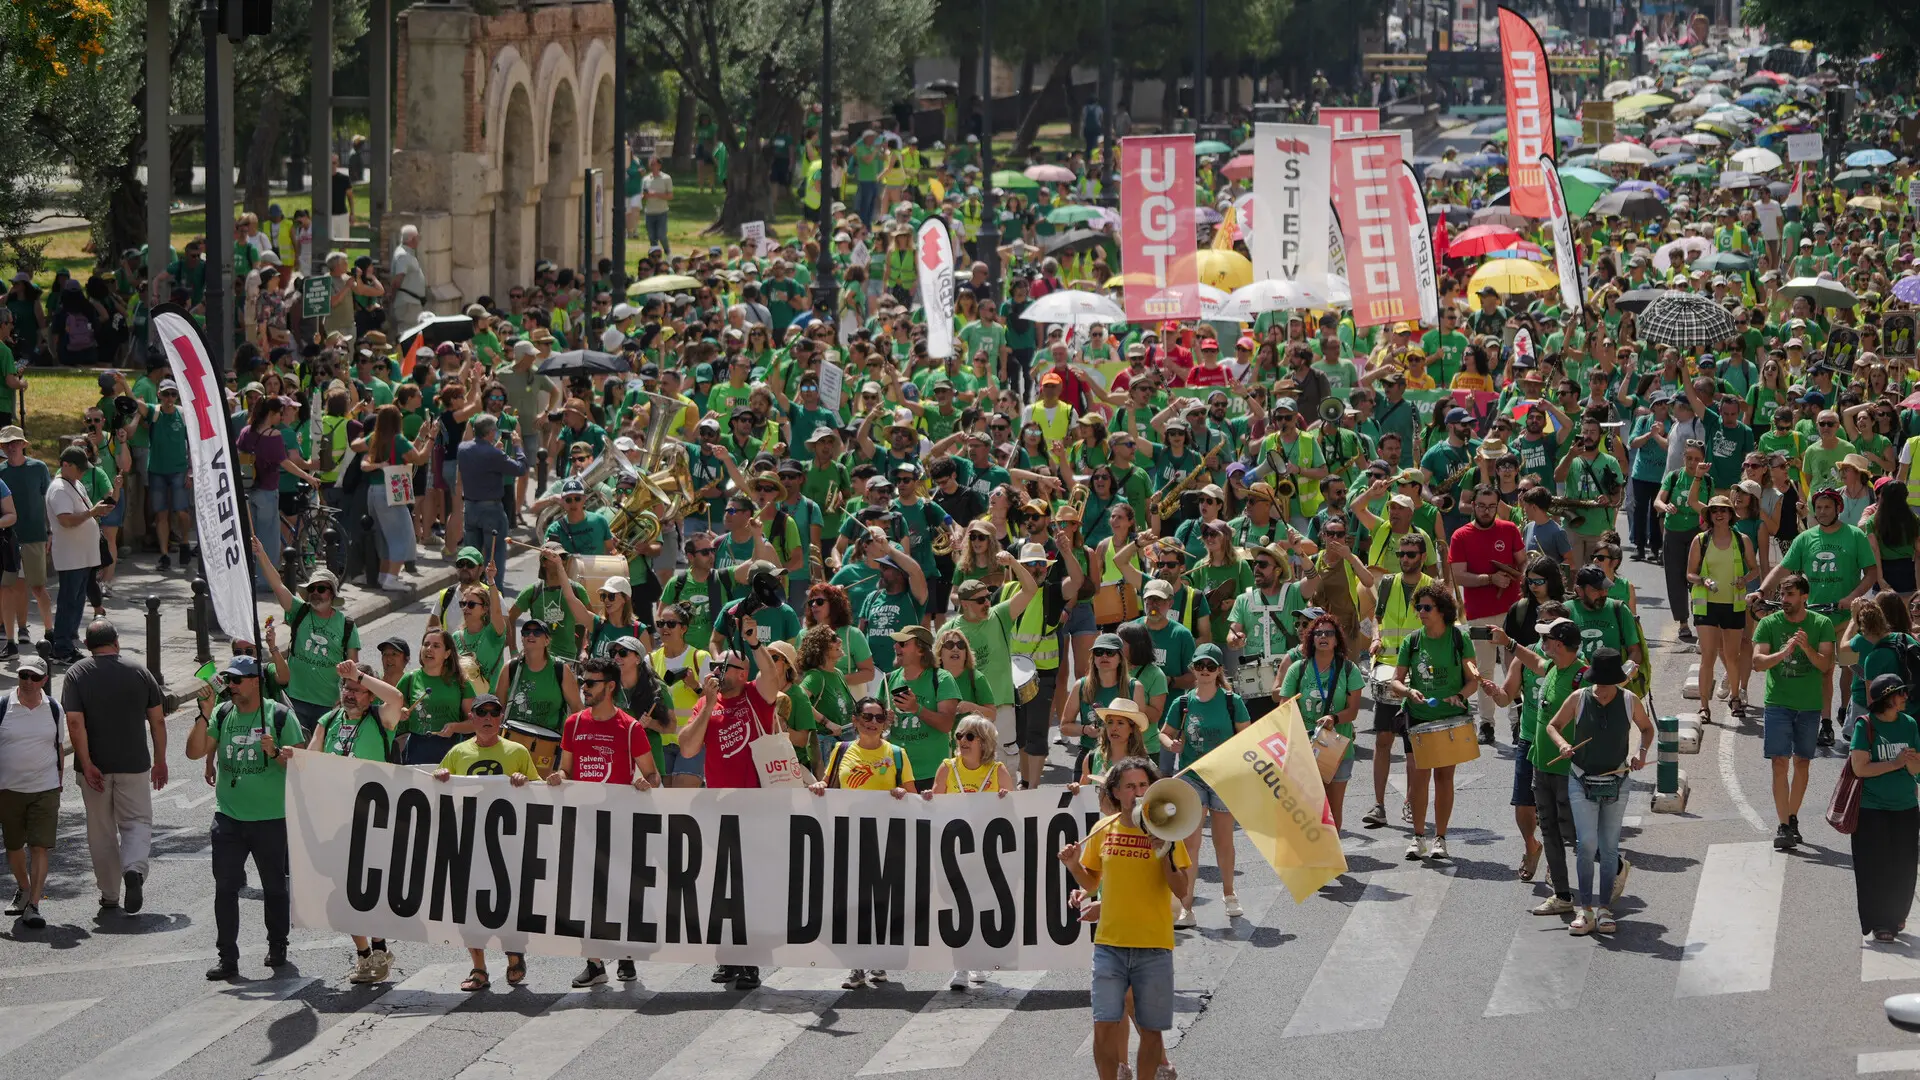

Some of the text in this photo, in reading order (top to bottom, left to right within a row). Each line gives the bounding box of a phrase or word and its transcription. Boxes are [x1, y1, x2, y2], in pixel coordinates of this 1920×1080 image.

[1140, 147, 1176, 289] UGT
[1282, 158, 1300, 281] STEPV
[1351, 145, 1400, 294] CCOO
[579, 754, 604, 763] Salvem
[579, 762, 605, 770] l'escola
[579, 770, 604, 778] pública
[765, 759, 788, 774] UGT
[1242, 749, 1321, 843] educació
[346, 781, 748, 945] CONSELLERA
